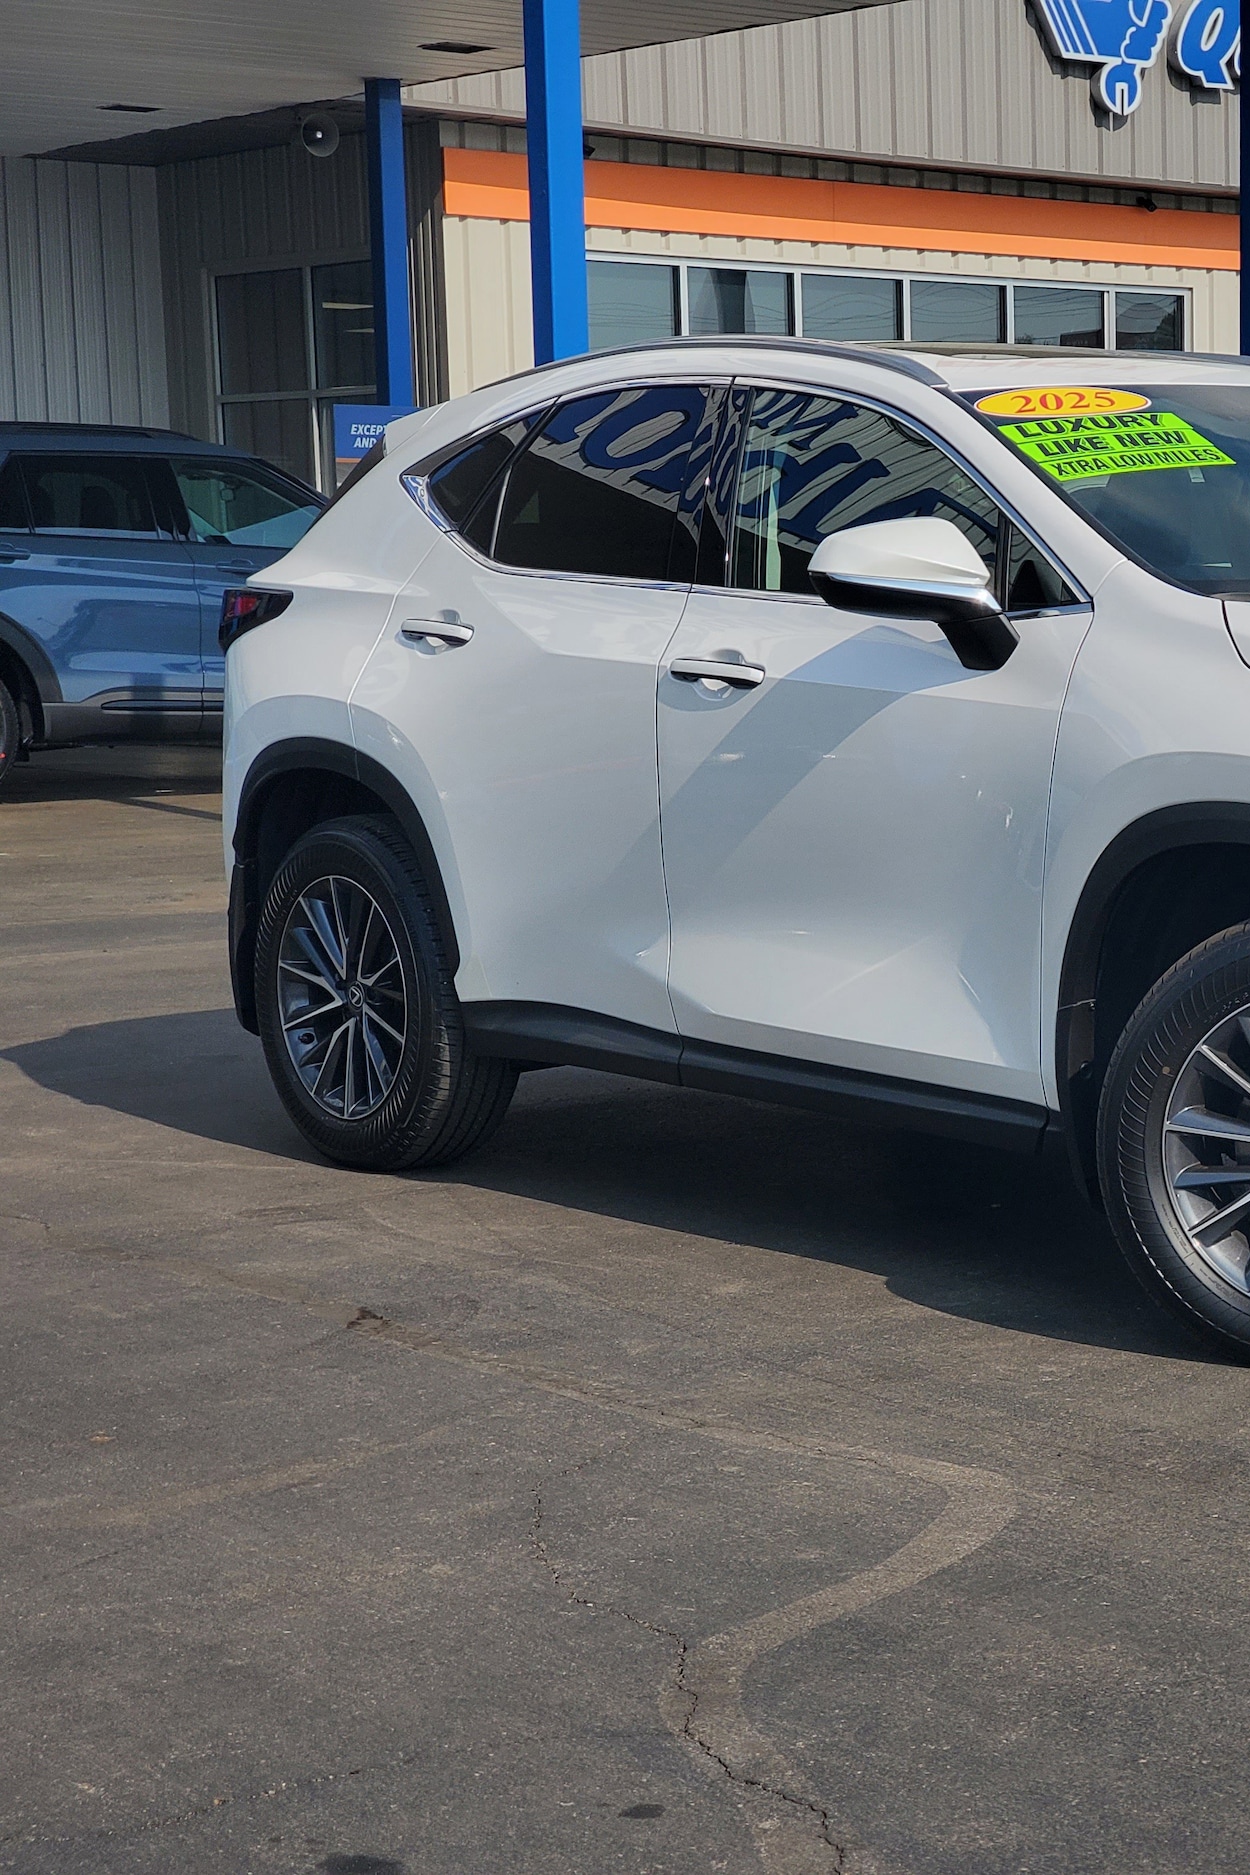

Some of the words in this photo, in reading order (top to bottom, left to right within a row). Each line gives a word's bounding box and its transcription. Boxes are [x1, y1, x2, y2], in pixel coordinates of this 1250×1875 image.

[1009, 391, 1117, 414] 2025
[1014, 413, 1166, 439] LUXURY
[1036, 434, 1111, 457] LIKE
[1113, 429, 1188, 449] NEW
[1051, 458, 1107, 477] XTRA
